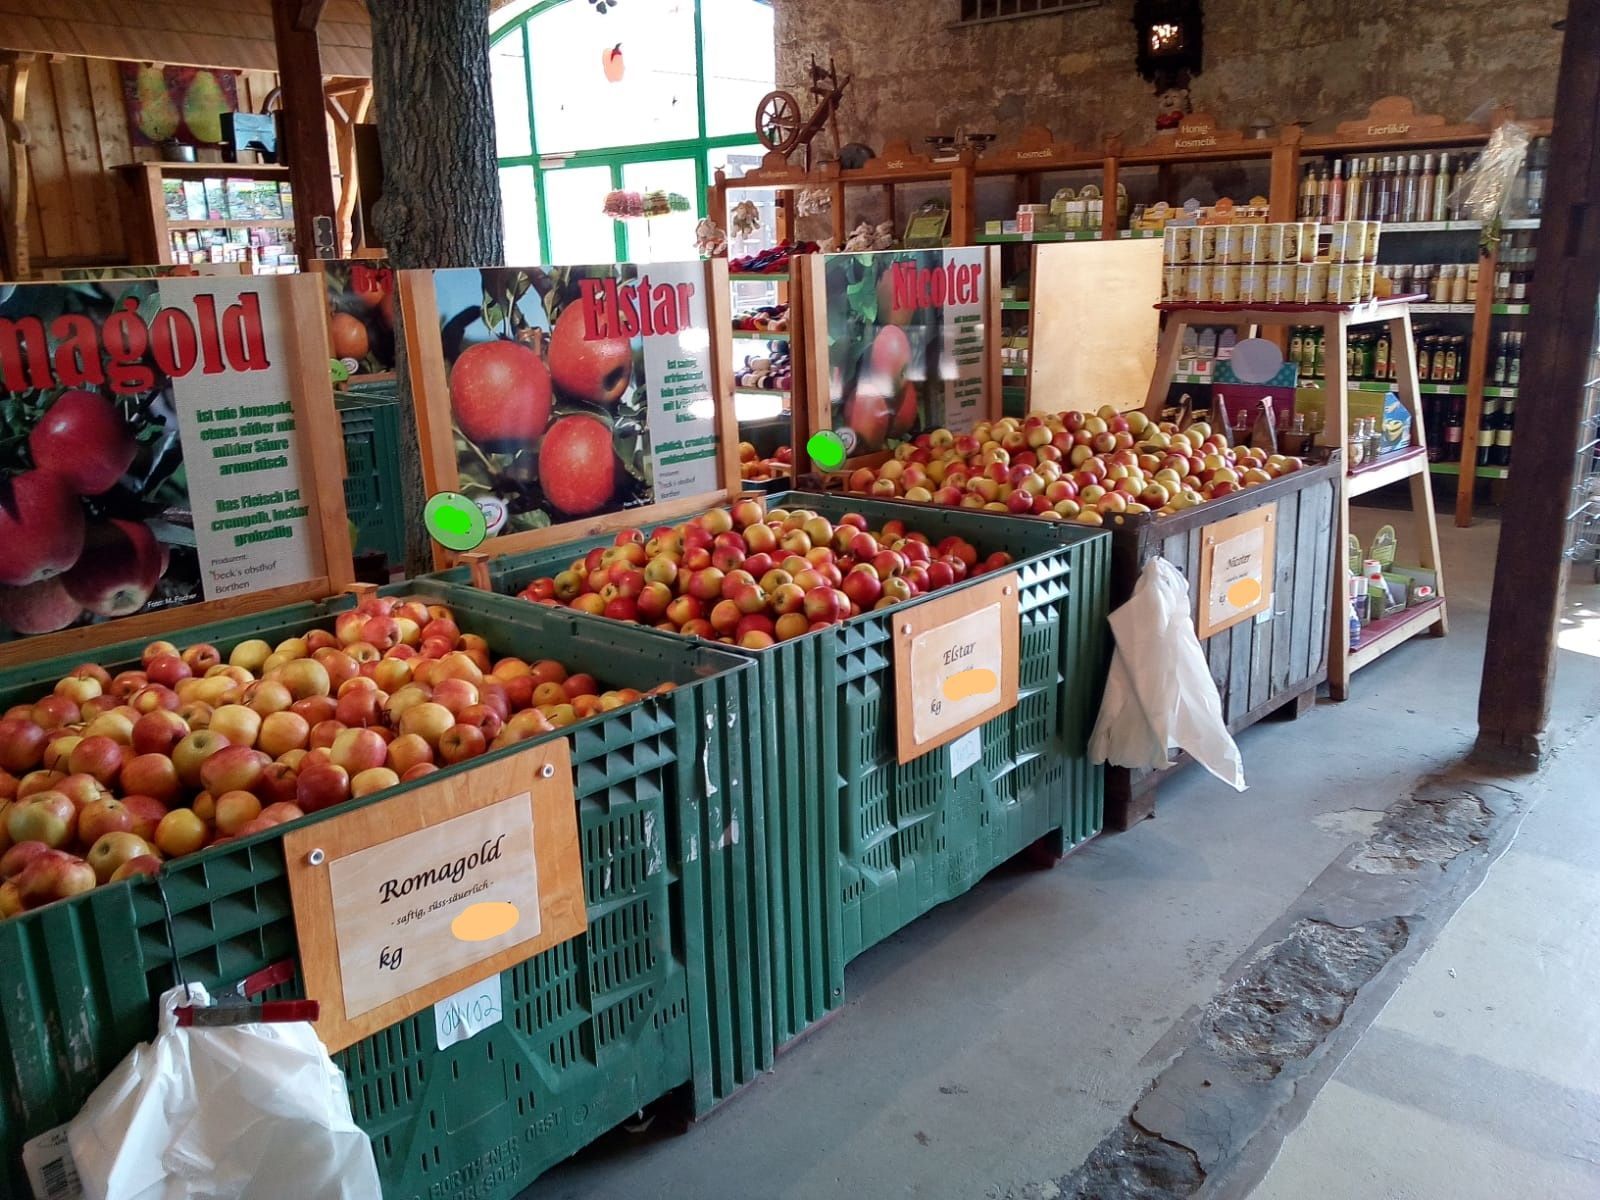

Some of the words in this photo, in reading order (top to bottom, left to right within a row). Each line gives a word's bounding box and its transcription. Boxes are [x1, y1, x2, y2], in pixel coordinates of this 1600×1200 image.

[1181, 124, 1212, 135] Honig-
[1175, 136, 1217, 149] Kosmetik
[1017, 149, 1053, 160] Kosmetik
[892, 257, 982, 312] Nicoter
[578, 275, 695, 341] Elstar
[254, 438, 289, 453] Säure
[220, 455, 288, 475] aromatisch
[241, 490, 284, 509] Fleisch
[244, 561, 277, 575] obsthof
[943, 641, 976, 666] Elstar
[930, 698, 942, 716] kg
[379, 834, 505, 904] Romagold
[396, 905, 426, 926] saftig,
[427, 880, 488, 914] süss-säuerlich
[379, 945, 403, 971] kg
